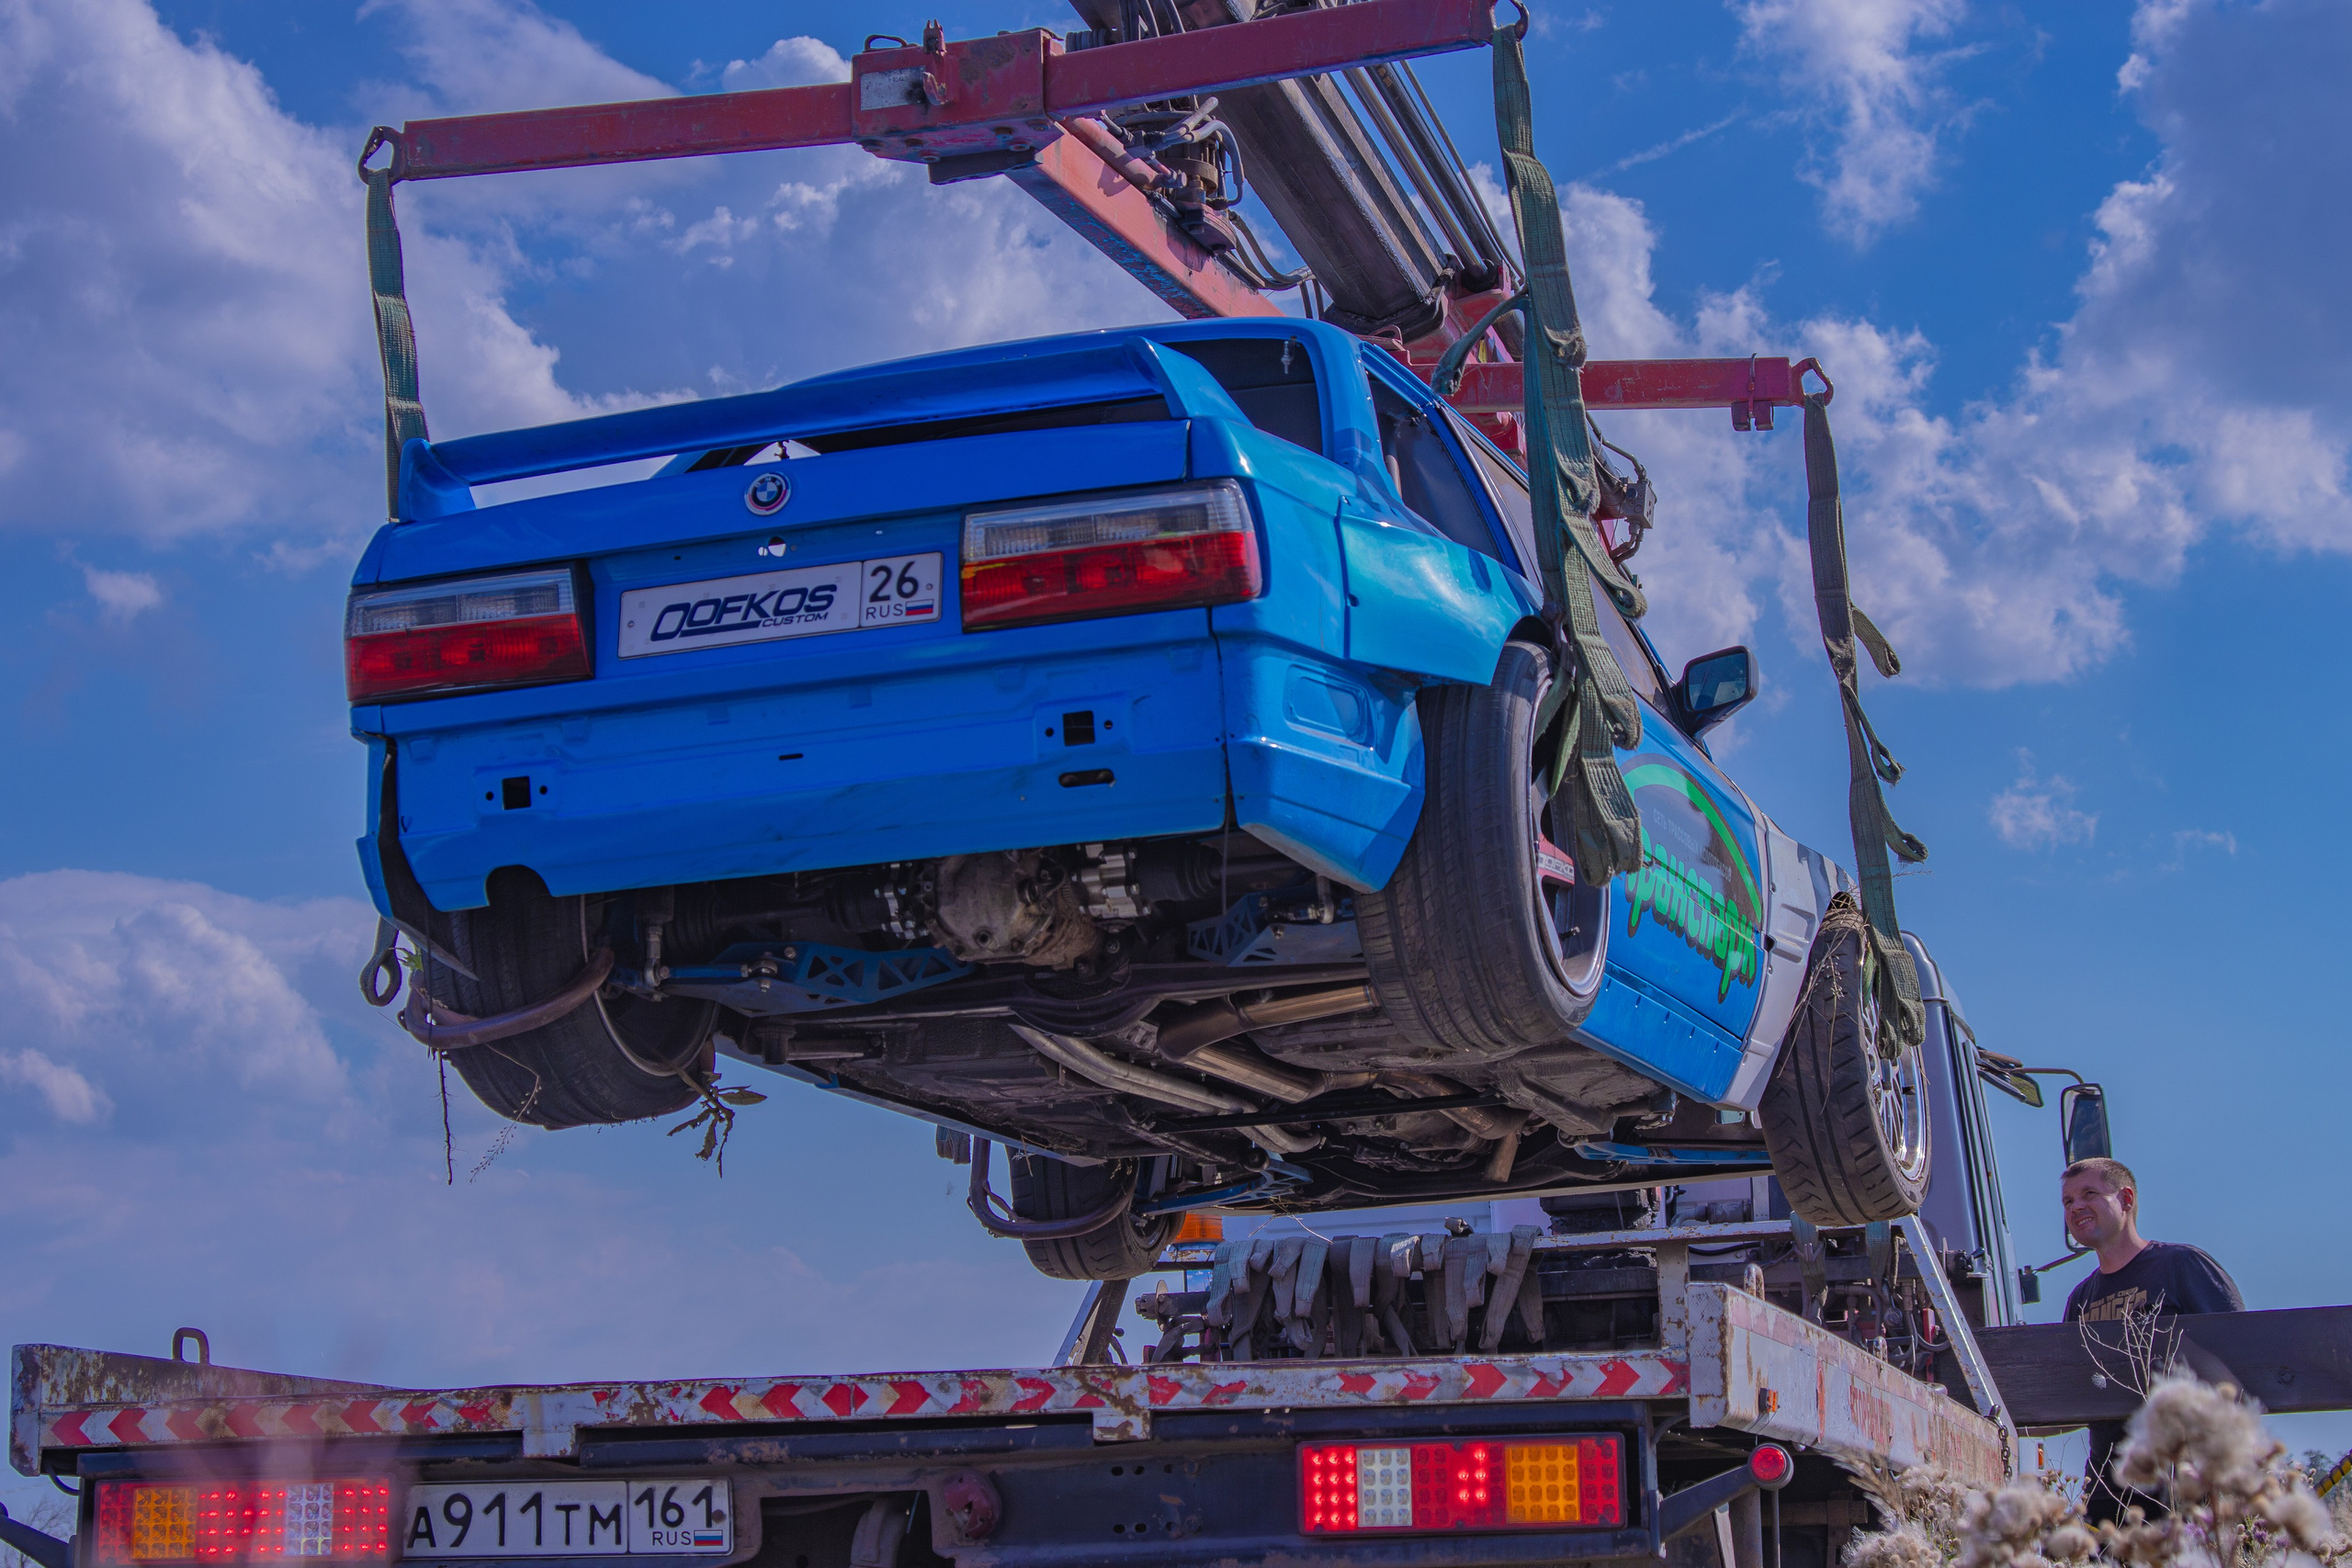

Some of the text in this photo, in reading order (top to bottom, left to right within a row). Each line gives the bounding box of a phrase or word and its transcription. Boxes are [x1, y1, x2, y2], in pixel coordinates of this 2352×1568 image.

[869, 560, 919, 603] 26
[762, 612, 829, 627] CUSTOM
[865, 603, 903, 620] RUS
[634, 1485, 713, 1529] 161
[651, 1530, 692, 1546] RUS
